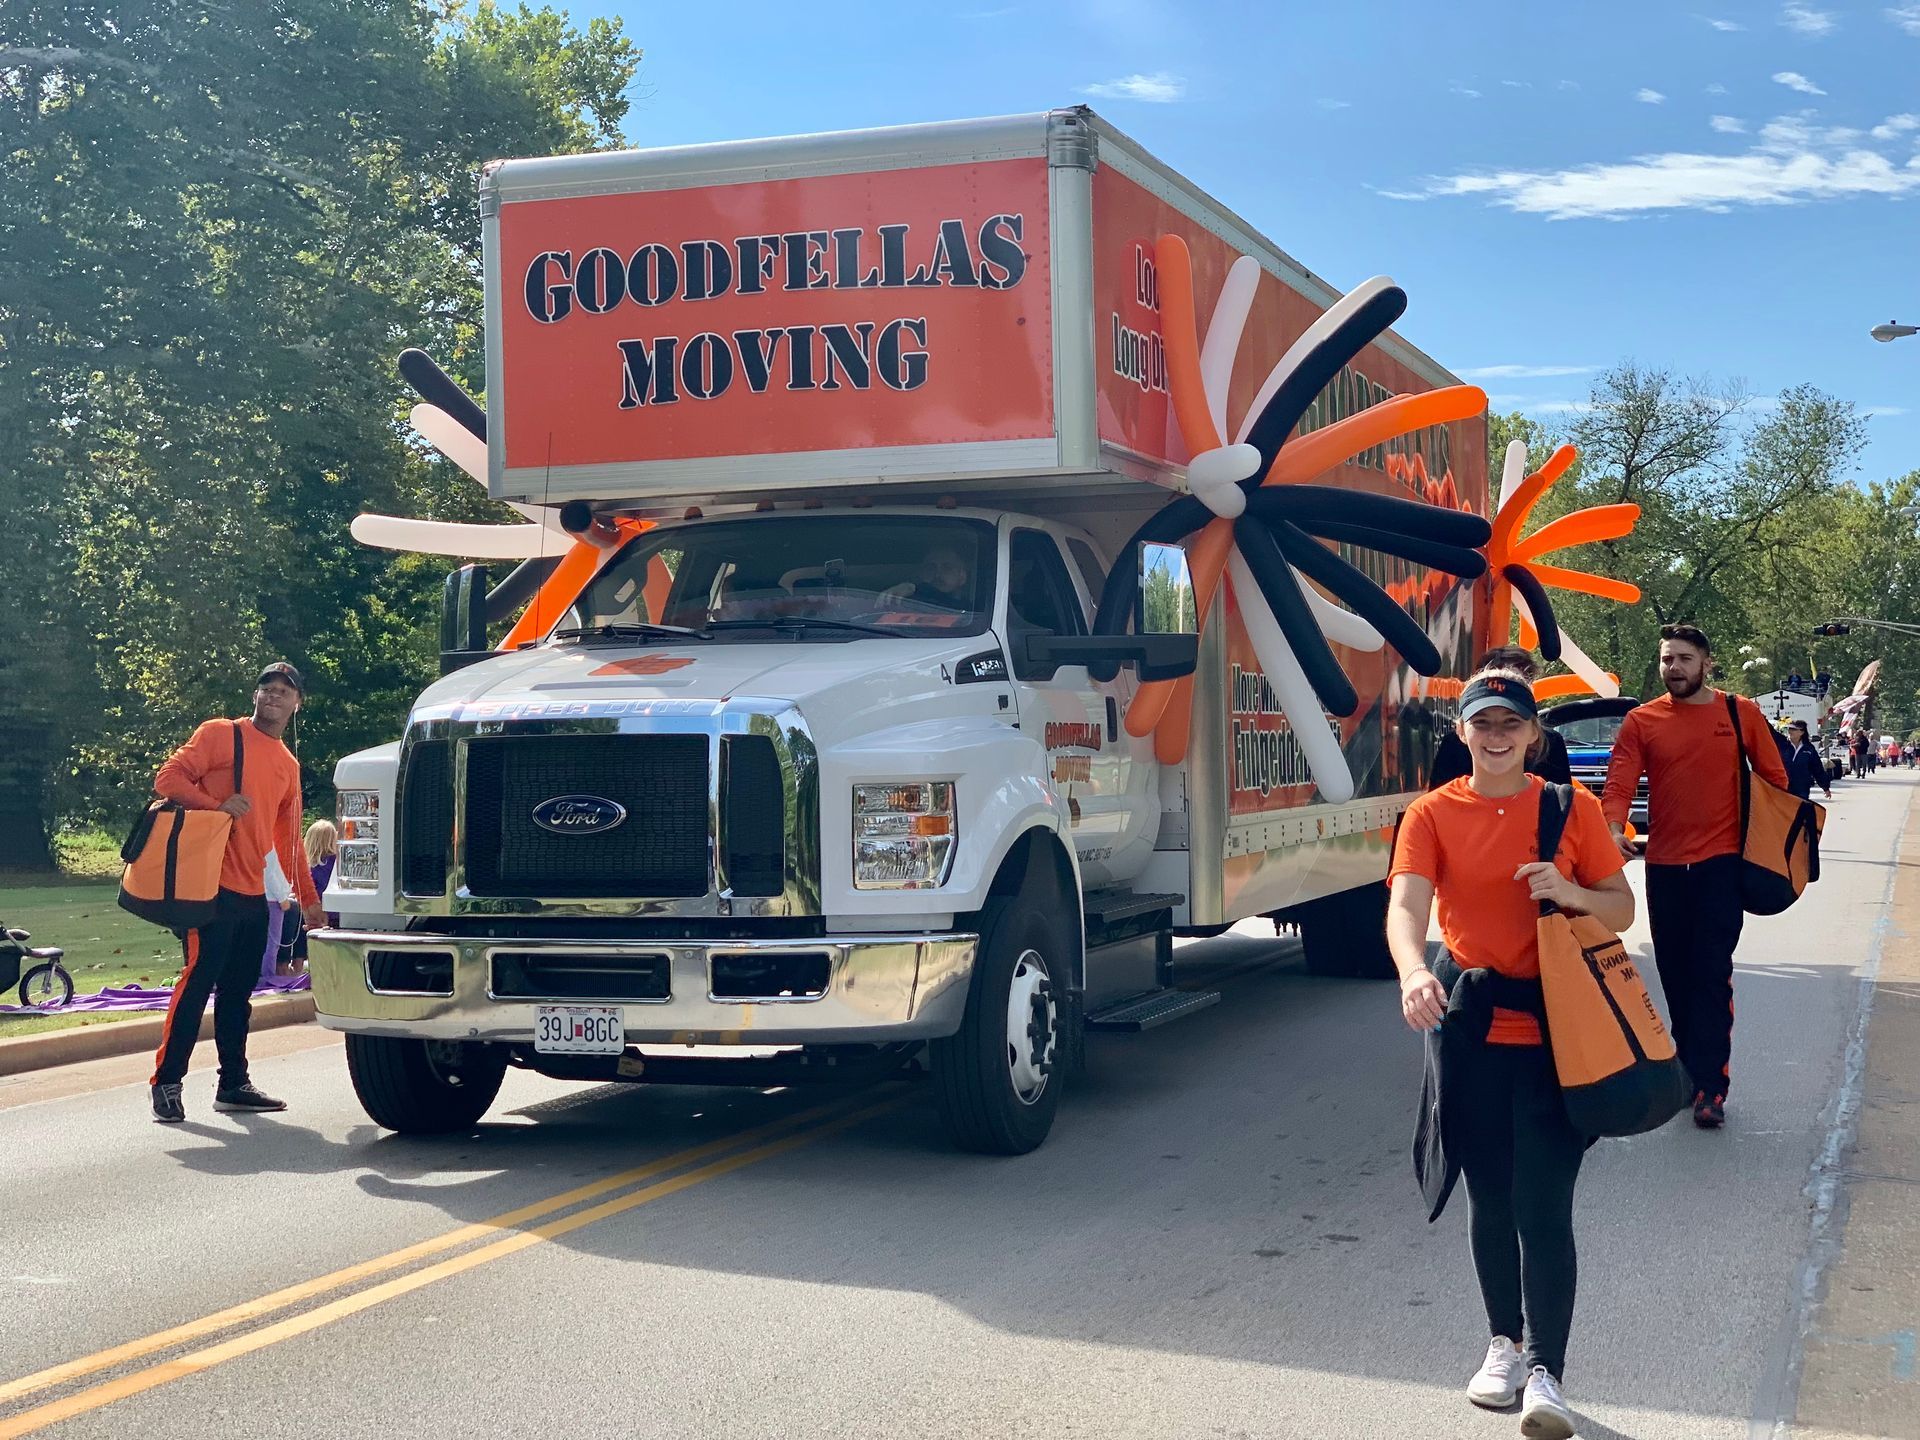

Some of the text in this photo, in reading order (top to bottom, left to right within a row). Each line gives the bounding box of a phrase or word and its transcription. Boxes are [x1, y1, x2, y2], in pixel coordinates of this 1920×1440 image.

[524, 213, 1027, 324] GOODFELLAS
[1136, 244, 1159, 314] Loc
[617, 317, 929, 409] MOVING
[1113, 312, 1149, 393] Long
[478, 700, 697, 719] SUPER DUTY
[1232, 663, 1259, 714] Move
[550, 801, 601, 825] Ford
[539, 1016, 619, 1042] 39J 8GC
